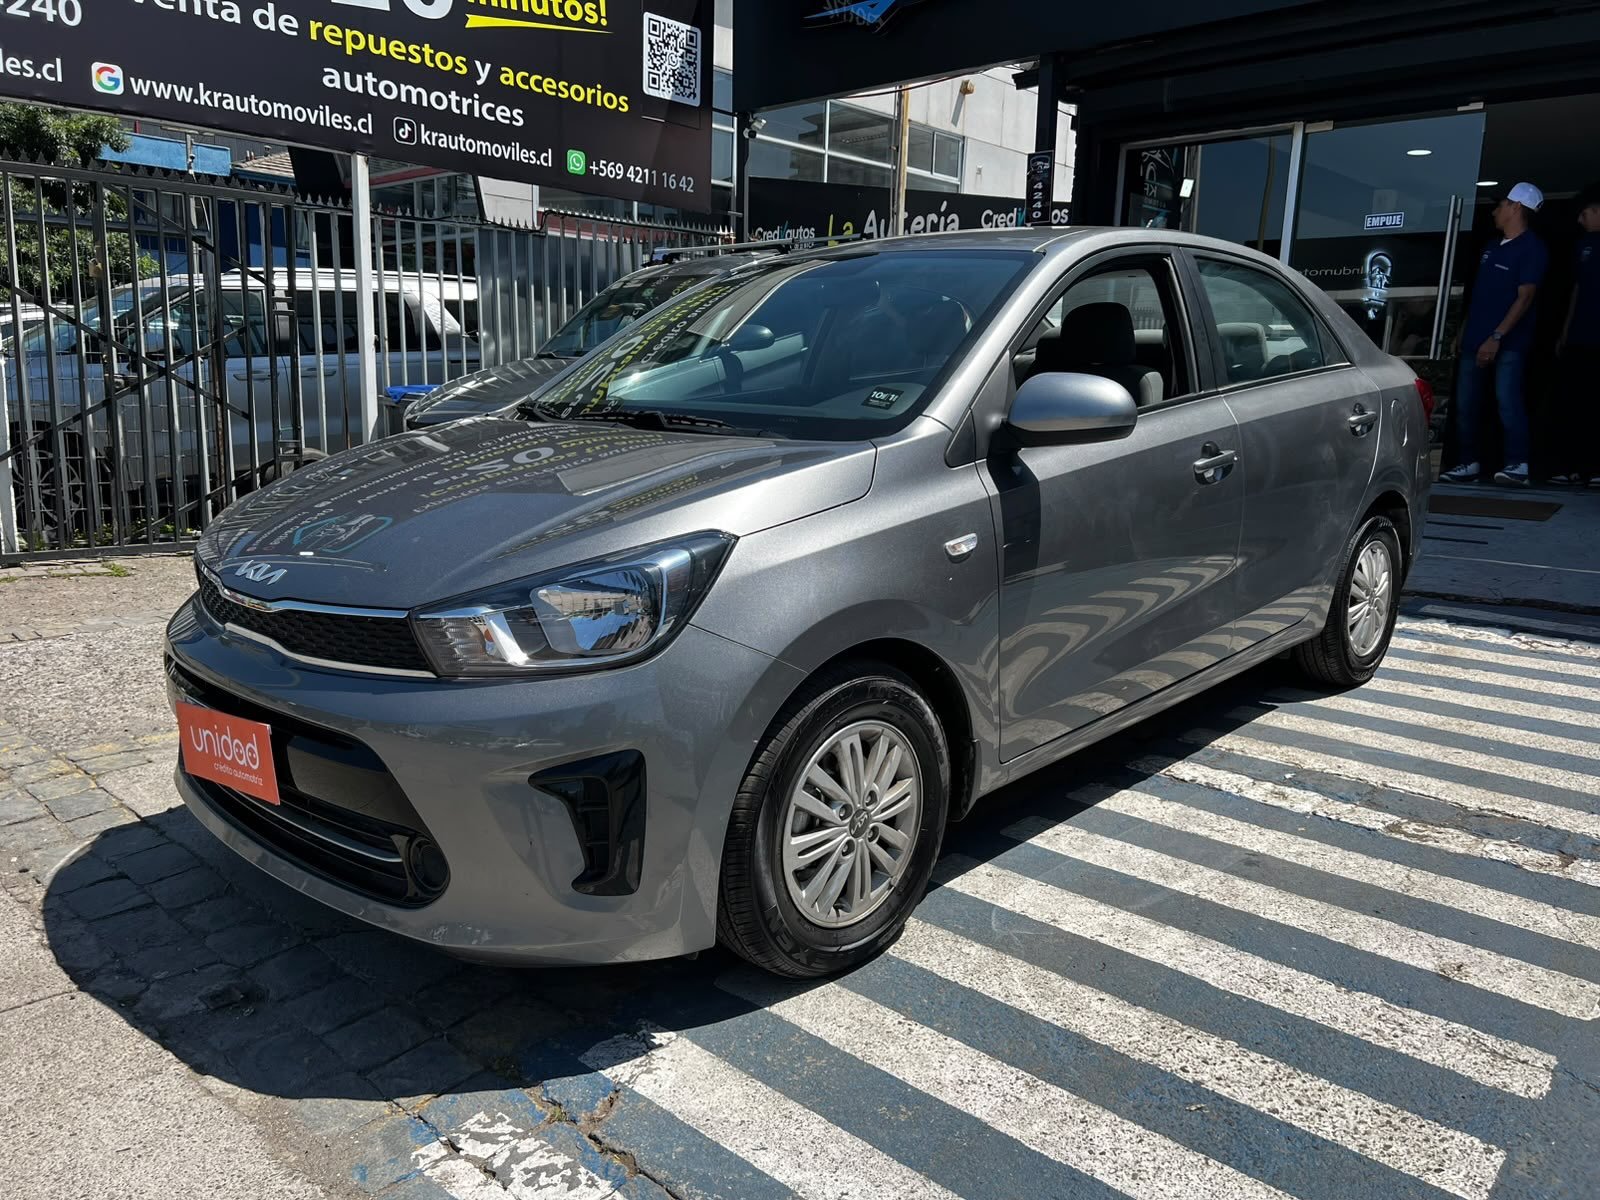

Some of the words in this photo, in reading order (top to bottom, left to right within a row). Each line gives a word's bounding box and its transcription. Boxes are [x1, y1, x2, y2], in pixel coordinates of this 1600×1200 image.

[0, 0, 83, 27] 240
[467, 0, 608, 26] nutos!
[134, 0, 241, 24] nta
[252, 2, 299, 36] de
[310, 19, 468, 75] repuestos
[474, 60, 491, 85] y
[499, 65, 630, 113] accesorios
[129, 77, 374, 136] www.krautomoviles.cl
[322, 67, 525, 127] automotrices
[420, 123, 553, 168] krautomoviles.cl
[589, 160, 625, 180] +569
[626, 165, 657, 186] 4211
[662, 171, 677, 190] 16
[679, 175, 695, 193] 42
[863, 200, 960, 240] Auería
[1366, 214, 1402, 228] EMPUJE
[234, 559, 288, 586] KIA
[189, 724, 260, 770] unidad
